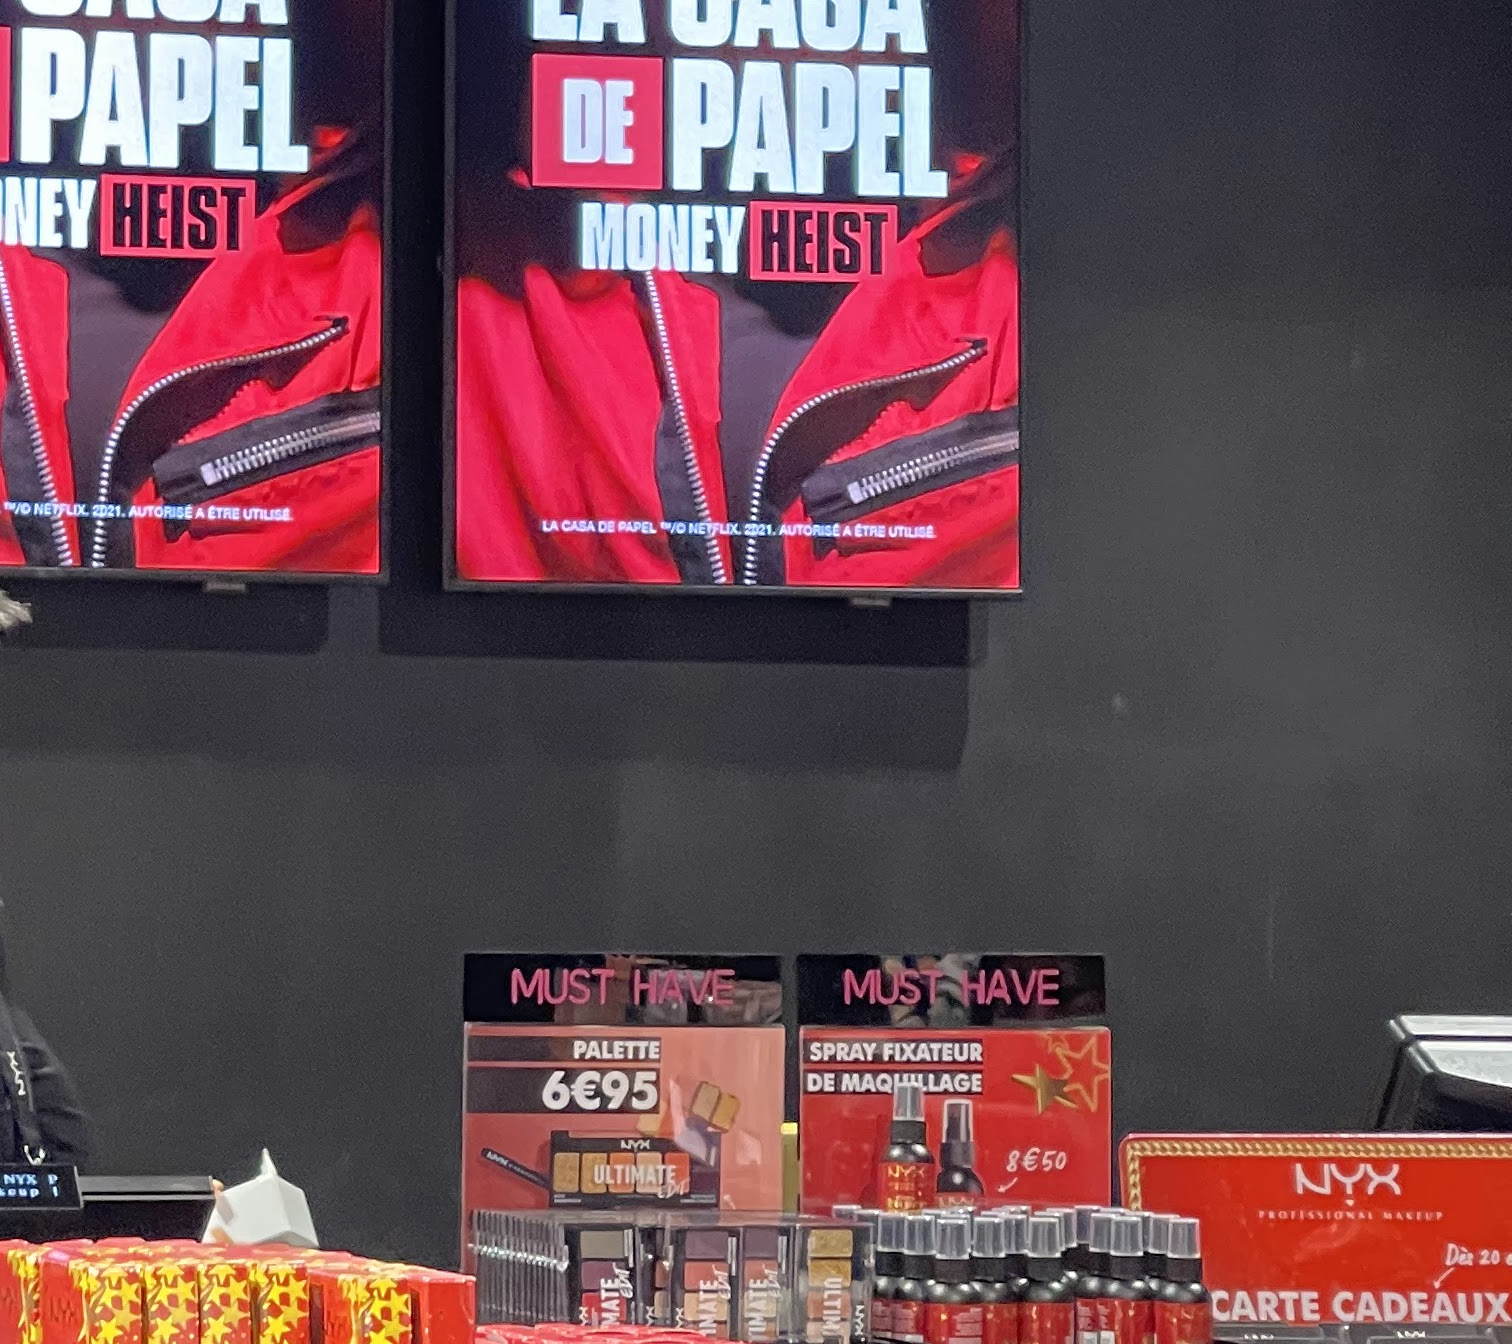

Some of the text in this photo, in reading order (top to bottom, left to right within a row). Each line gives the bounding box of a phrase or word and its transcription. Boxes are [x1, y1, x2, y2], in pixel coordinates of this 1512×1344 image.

[19, 27, 309, 174] PAPEL
[561, 58, 948, 199] DE PAPEL
[111, 183, 247, 252] HEIST
[580, 203, 889, 277] MONEY HEIST
[128, 503, 192, 519] AUTORISÉ
[542, 519, 559, 532] LA
[561, 520, 595, 533] CASA
[598, 520, 615, 533] DE
[618, 520, 657, 534] PAPEL
[779, 522, 840, 538] AUTORISÉ
[510, 968, 736, 1006] MUST HAVE
[842, 968, 1060, 1006] MUST HAVE
[572, 1039, 660, 1061] PALETTE
[809, 1041, 983, 1064] SPRAY FIXATEUR
[541, 1070, 658, 1111] 6€95
[806, 1072, 983, 1094] DE MAQUILLAGE
[593, 1164, 677, 1185] ULTIMATE
[1005, 1147, 1068, 1173] 8€50
[3, 1173, 38, 1185] NYX
[48, 1173, 59, 1185] P
[1295, 1162, 1402, 1196] NYX
[1479, 1248, 1501, 1266] 20
[1211, 1290, 1512, 1323] CARTE CADEAUX
